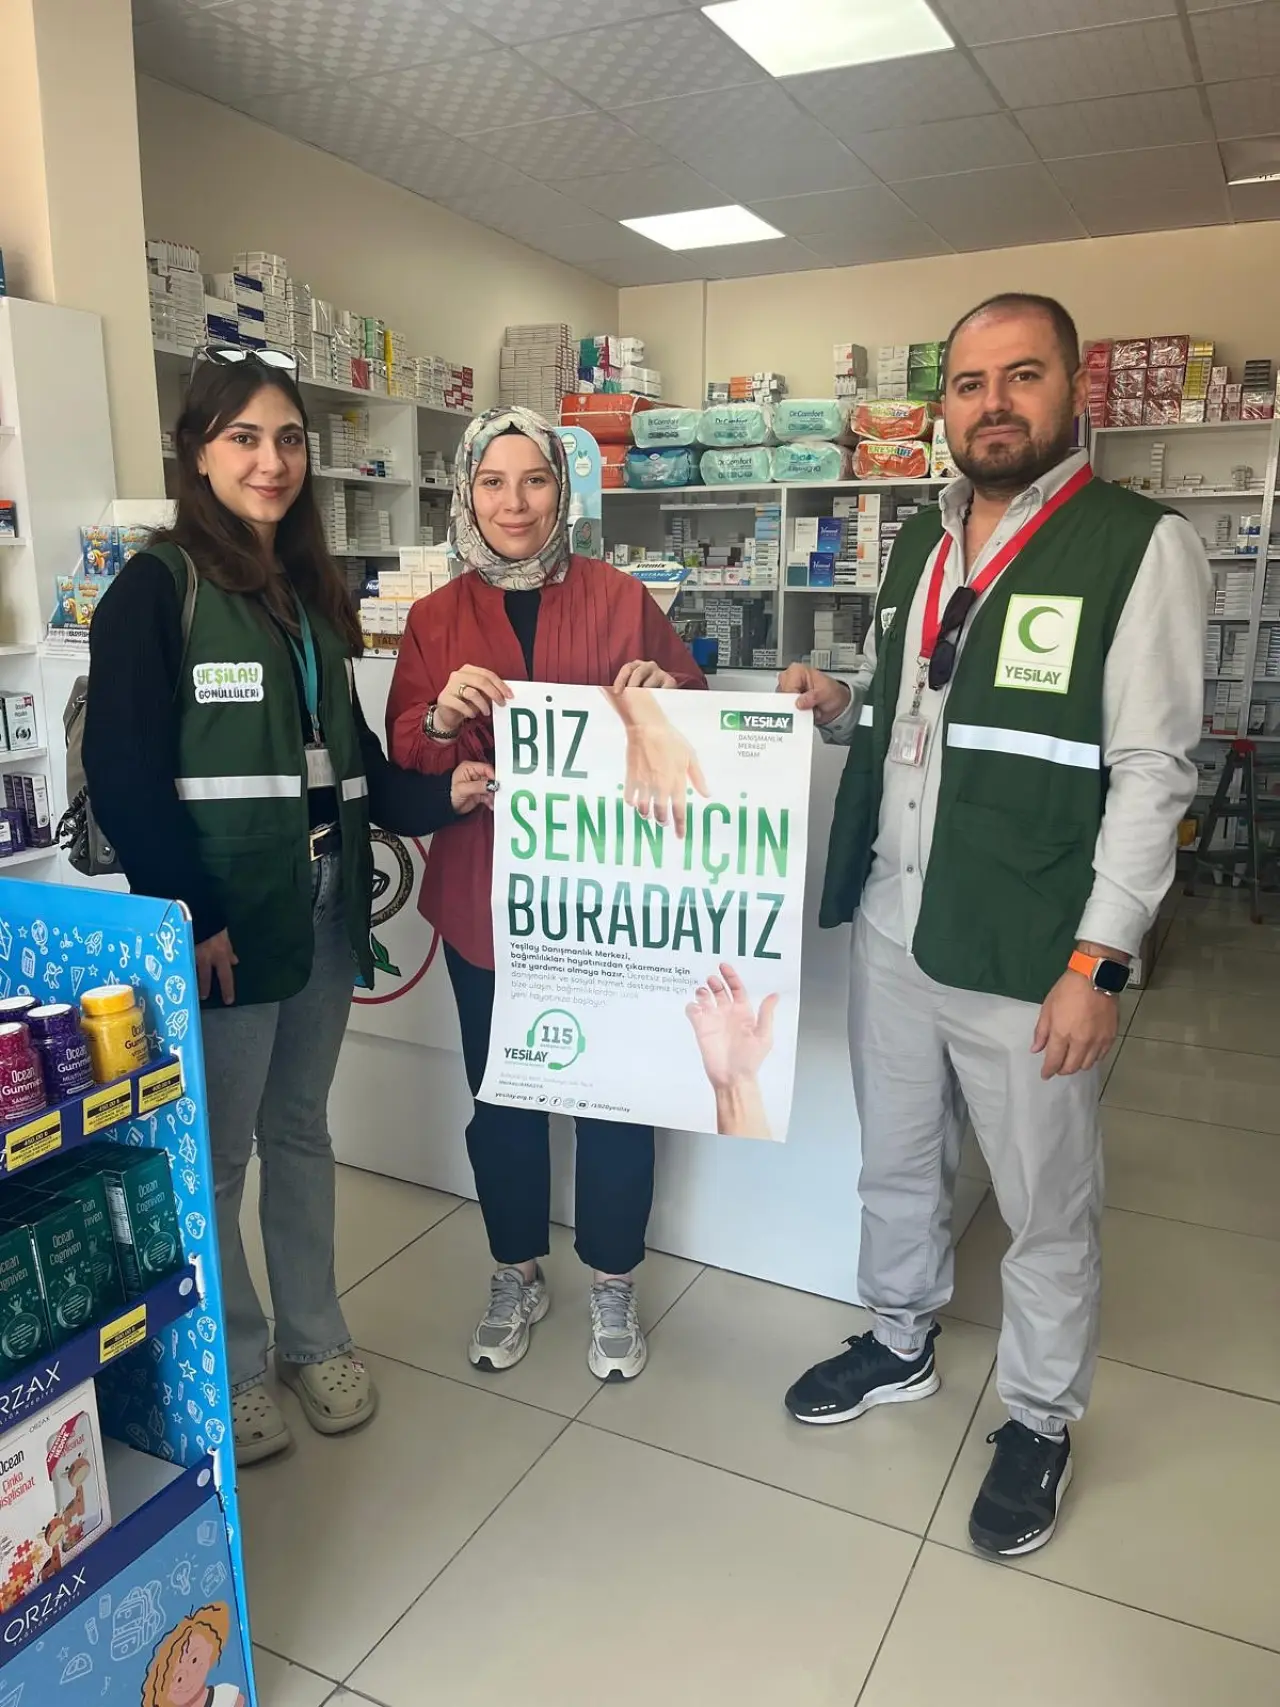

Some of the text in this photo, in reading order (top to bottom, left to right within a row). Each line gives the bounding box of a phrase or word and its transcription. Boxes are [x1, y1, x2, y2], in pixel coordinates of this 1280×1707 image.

[509, 695, 590, 779] BİZ
[510, 783, 790, 884] SENİN İÇİN
[508, 872, 786, 960] BURADAYIZ
[510, 942, 540, 954] Yeşilay
[542, 945, 593, 957] Danışmanlık
[510, 952, 691, 976] bağımlılıkları hayatınızdan çıkarmanız için
[528, 964, 565, 972] yardımcı
[567, 967, 599, 977] olmaya
[541, 1025, 574, 1045] 115
[0, 1254, 20, 1273] cean
[4, 1566, 86, 1643] ORZAX
